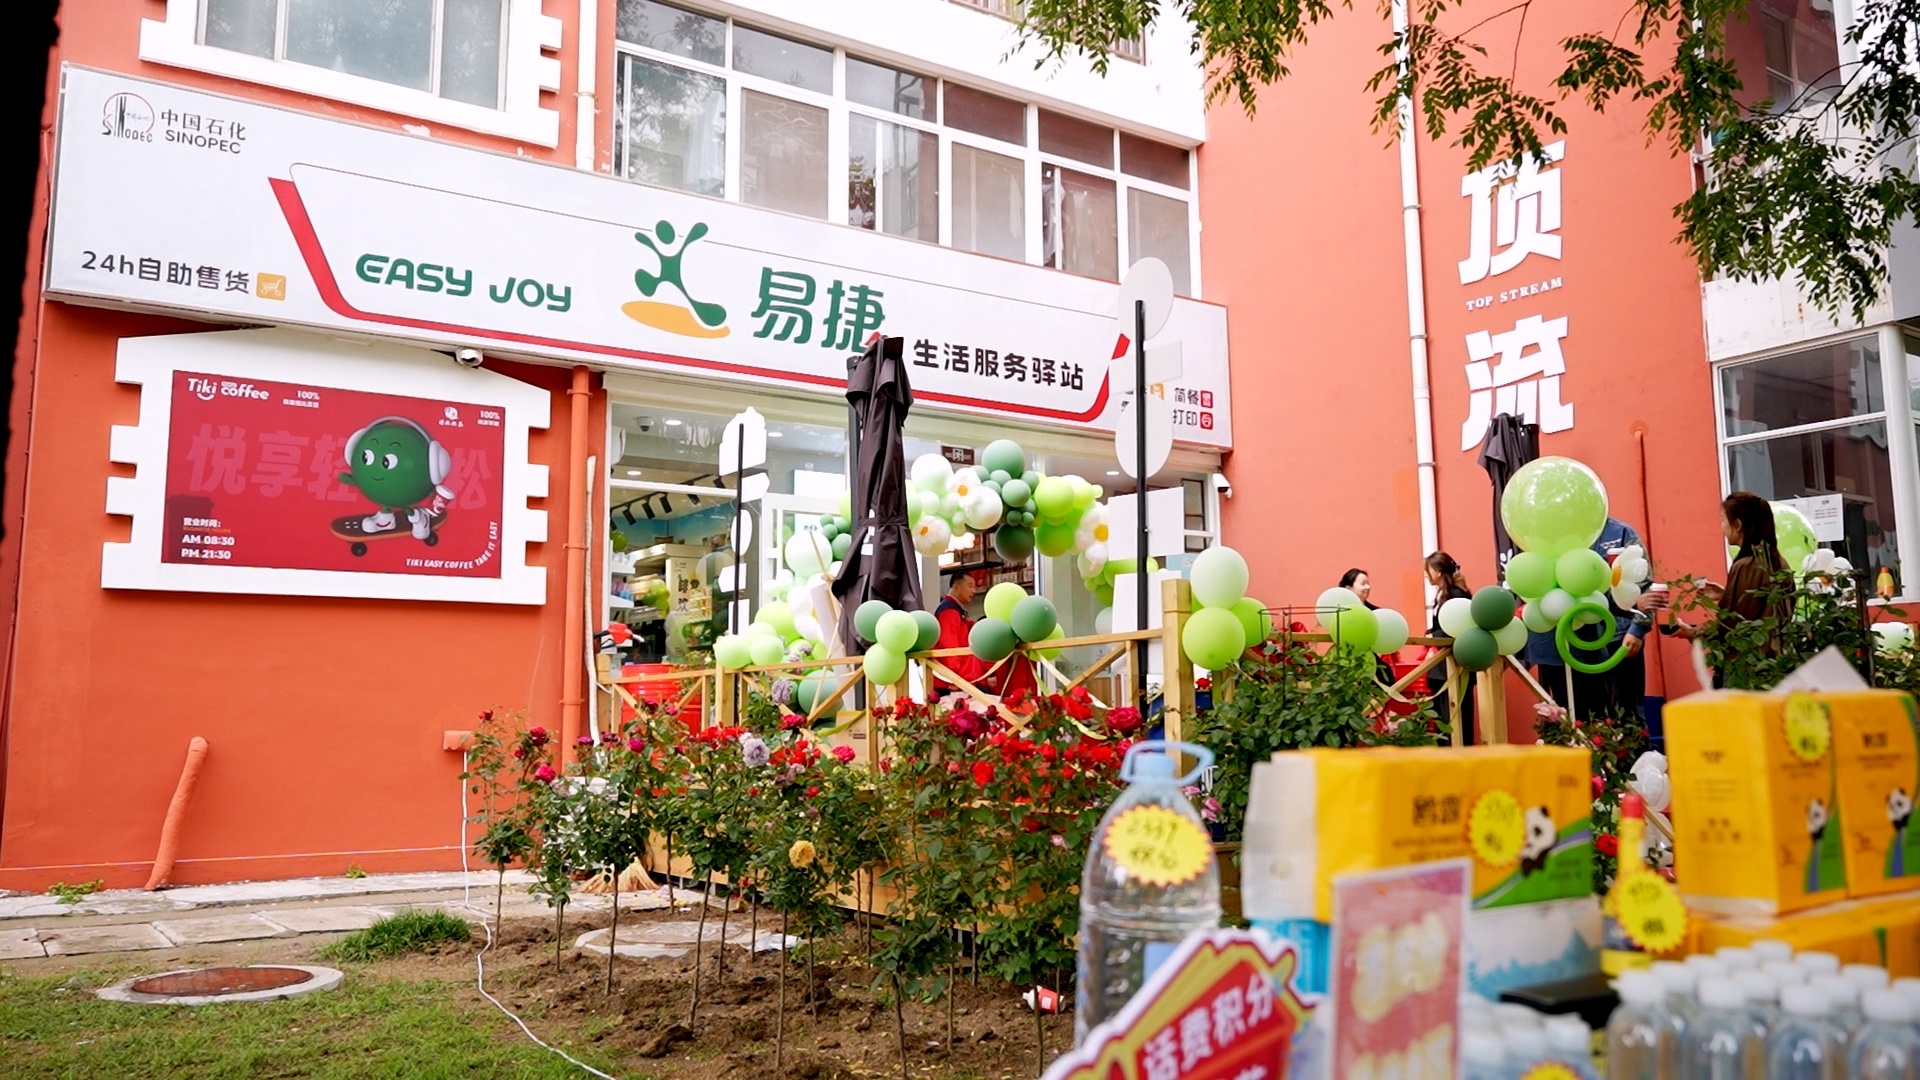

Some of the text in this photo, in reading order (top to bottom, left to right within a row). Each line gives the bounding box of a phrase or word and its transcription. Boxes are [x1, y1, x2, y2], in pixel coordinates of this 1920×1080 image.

[161, 109, 247, 141] 中国石化
[165, 129, 242, 154] SINOPEC
[82, 250, 250, 295] 24h自助售货
[355, 253, 572, 313] EASY JOY
[1466, 276, 1563, 312] TOP STREAM
[750, 266, 887, 354] 易捷
[912, 338, 1084, 391] 生活服务驿站
[187, 377, 217, 394] Tiki
[297, 390, 321, 401] 100%
[1174, 387, 1199, 406] 简餐
[1173, 408, 1198, 427] 打印
[201, 549, 232, 560] 21:30
[203, 535, 235, 546] 08:30
[406, 558, 423, 567] TIKI
[424, 559, 444, 568] EASY
[444, 560, 473, 570] COFFEE
[474, 550, 492, 566] TAKE
[489, 521, 498, 540] EASY
